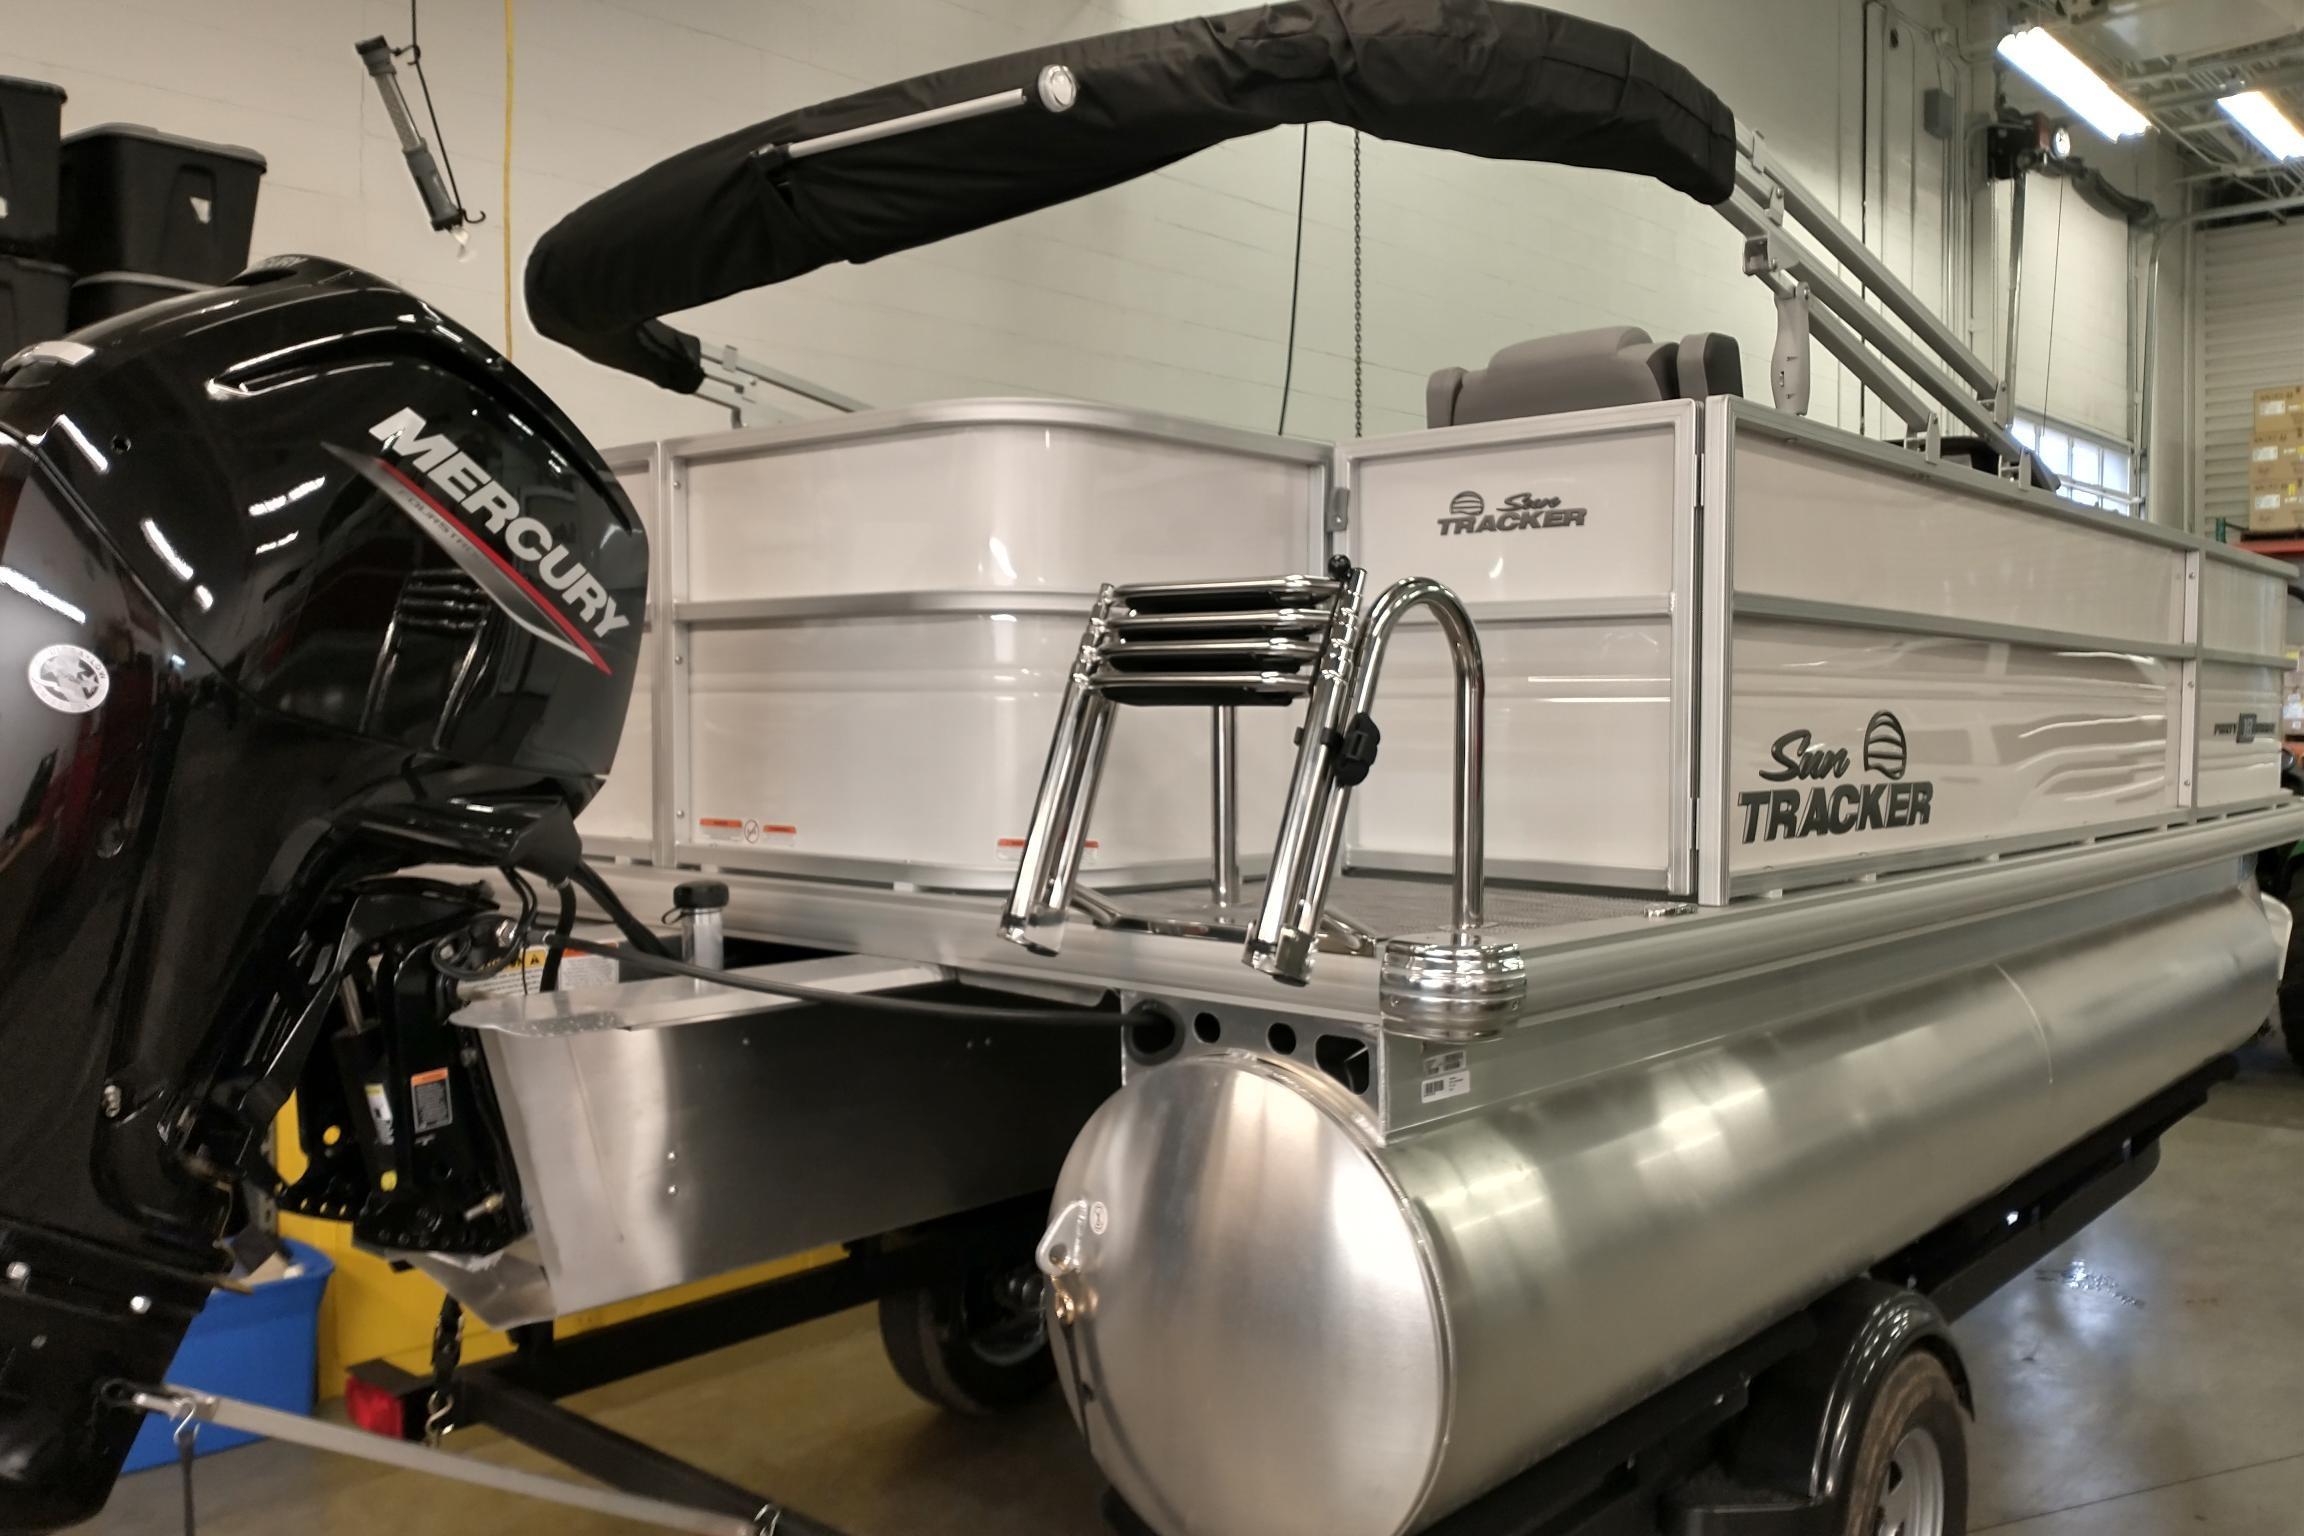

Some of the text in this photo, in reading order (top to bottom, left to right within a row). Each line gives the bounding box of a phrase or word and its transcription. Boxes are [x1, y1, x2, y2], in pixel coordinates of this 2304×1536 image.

[368, 406, 630, 638] MERCURY
[1437, 508, 1587, 536] TRACKER
[1496, 492, 1561, 511] Sun
[1759, 729, 1850, 782] Sun
[1737, 781, 1934, 845] TRACKER
